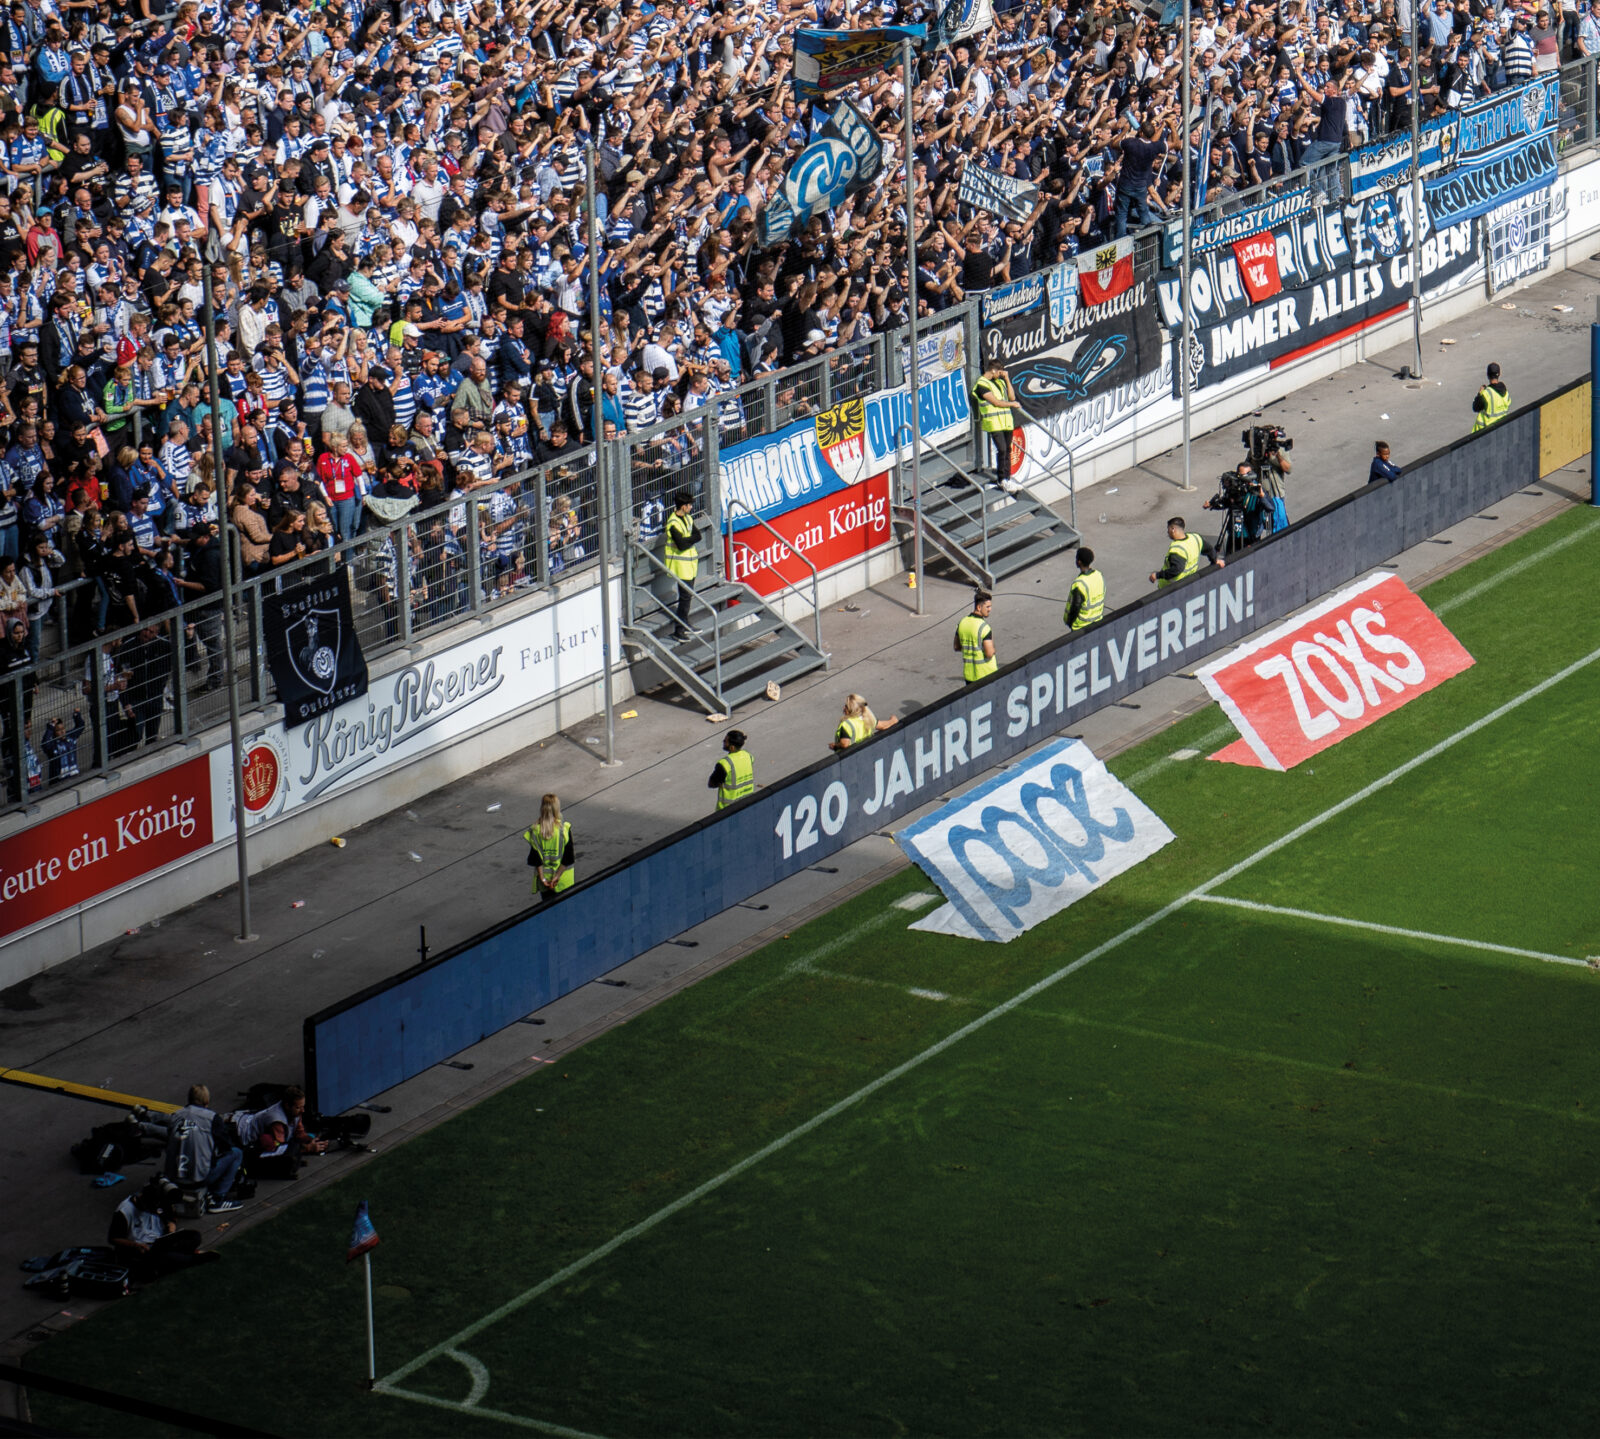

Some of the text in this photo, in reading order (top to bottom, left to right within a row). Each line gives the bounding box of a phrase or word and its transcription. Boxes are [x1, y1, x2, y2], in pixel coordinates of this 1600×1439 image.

[1459, 97, 1525, 153] METROPOL
[959, 187, 1000, 216] ULTRA
[1158, 209, 1350, 326] KOHRTE
[987, 309, 1046, 361] Proud
[1212, 296, 1301, 367] IMMER
[1309, 263, 1384, 325] ALLES
[866, 367, 968, 460] DUISBURG
[732, 494, 887, 582] Heute ein König
[520, 620, 602, 671] Fankurv
[1254, 606, 1426, 741] ZOXS
[300, 705, 393, 785] König
[391, 646, 504, 735] Pilsener
[775, 569, 1256, 860] 120 JAHRE SPIELVEREIN!
[67, 833, 109, 871] ein
[114, 794, 197, 854] König
